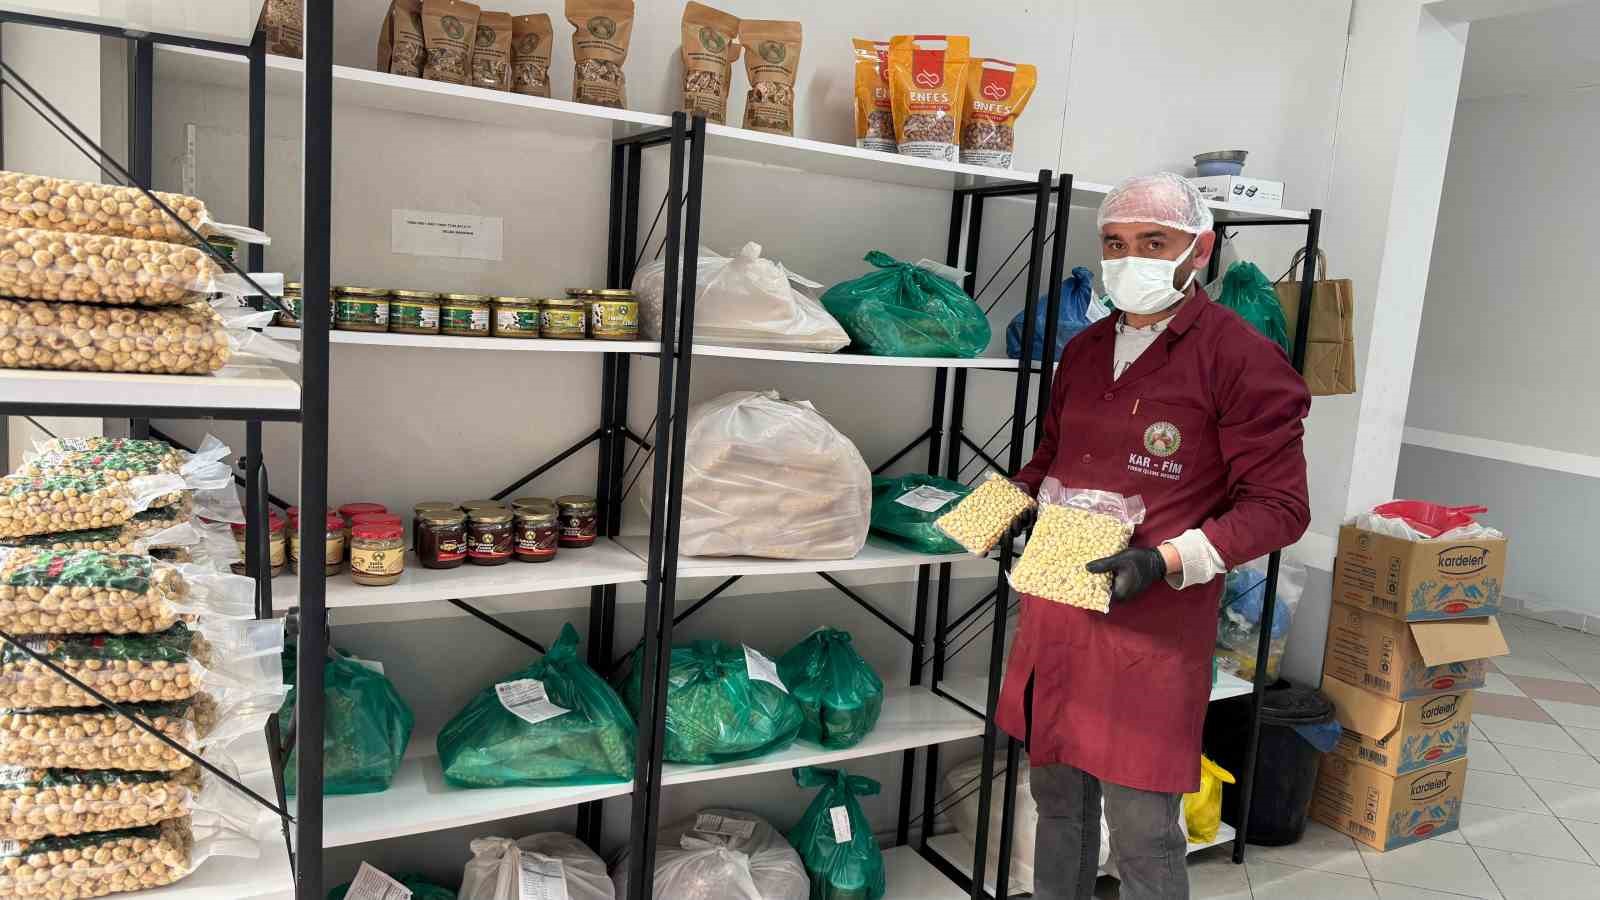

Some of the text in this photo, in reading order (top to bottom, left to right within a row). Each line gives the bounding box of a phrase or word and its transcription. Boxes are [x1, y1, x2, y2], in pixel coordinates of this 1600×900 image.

[1129, 453, 1151, 467] KAR
[1438, 553, 1484, 568] kardelen
[1421, 702, 1456, 720] kardelen
[1411, 777, 1447, 796] kardelen
